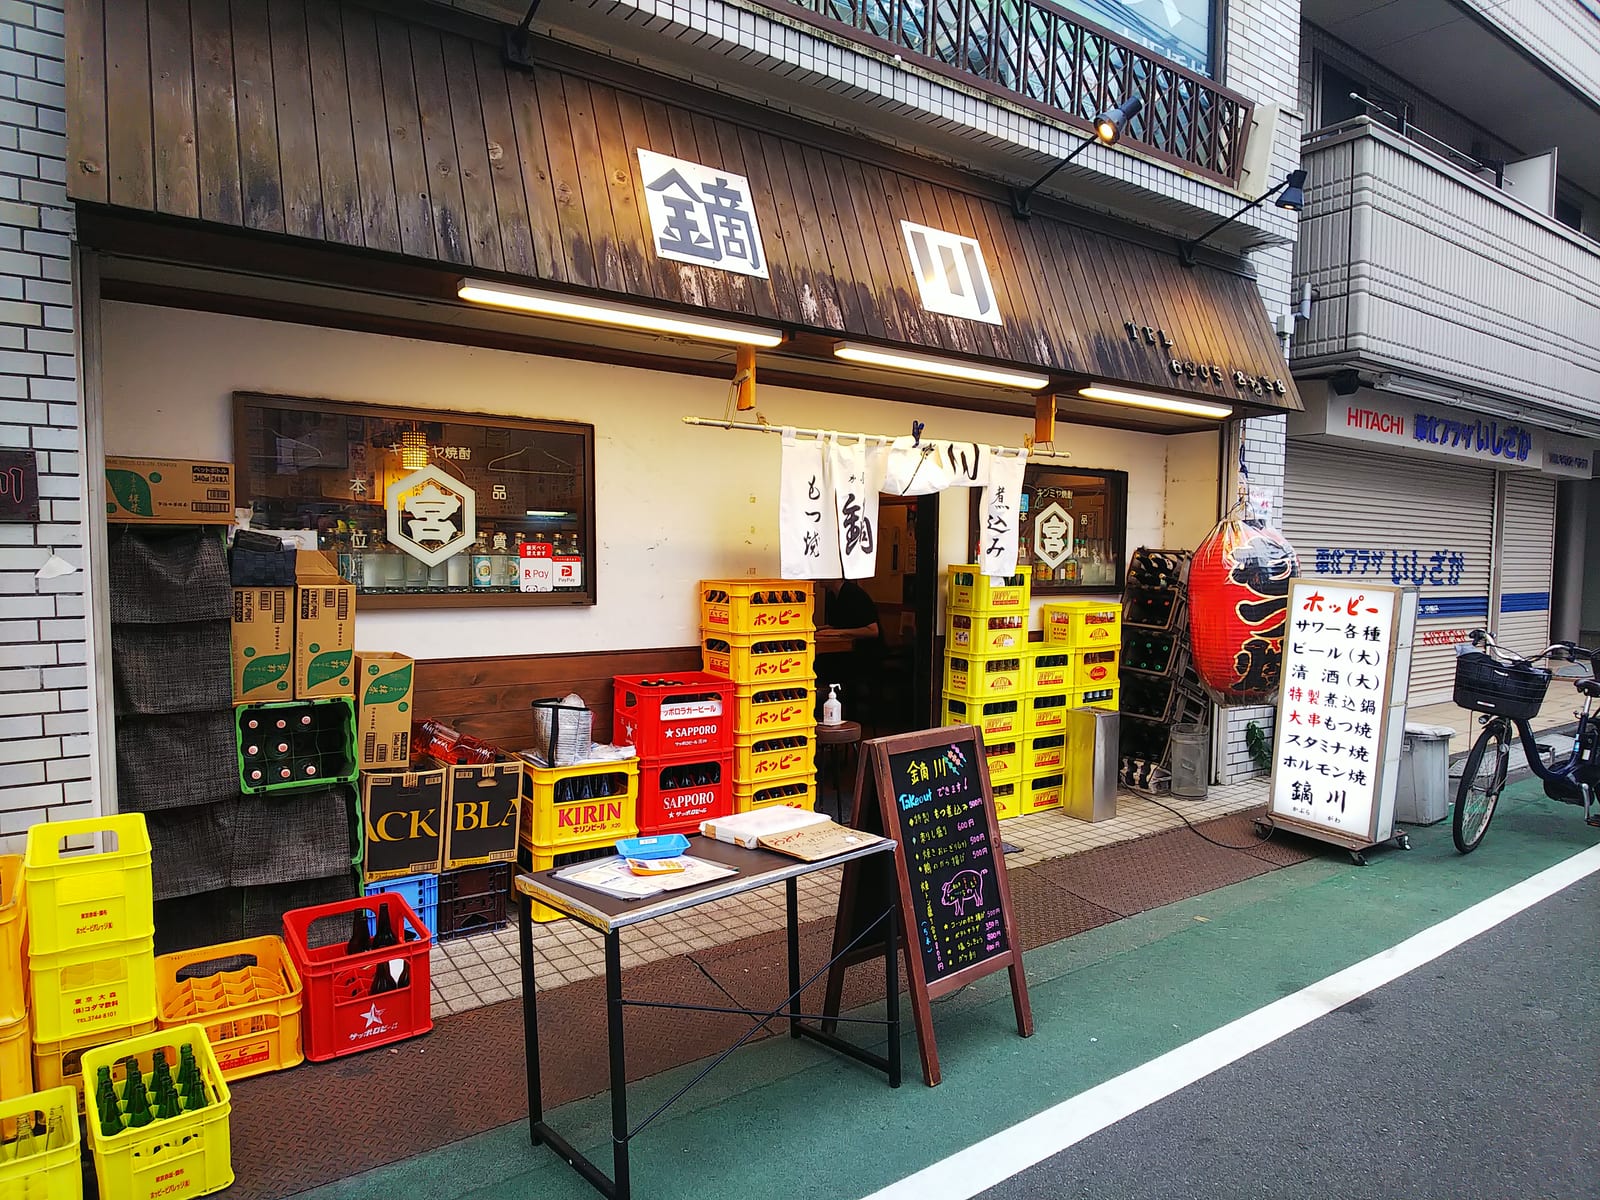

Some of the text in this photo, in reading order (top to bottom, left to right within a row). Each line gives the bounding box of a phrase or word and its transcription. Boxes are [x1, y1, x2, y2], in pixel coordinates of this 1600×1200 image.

[911, 231, 991, 315] 川
[1347, 407, 1404, 435] HITACHI
[1303, 591, 1379, 616] ホッピー
[754, 609, 801, 626] ホッピー
[1295, 619, 1381, 642] サワー各種
[754, 658, 801, 675] ホッピー
[755, 706, 802, 725] ホッピー
[675, 725, 717, 738] SAPPORO
[1285, 733, 1369, 763] スタミナ焼
[755, 754, 802, 773] ホッピー
[1283, 755, 1367, 787] ホルモン焼
[664, 792, 714, 810] SAPPORO
[899, 788, 933, 811] Takeout
[558, 802, 622, 828] KIRIN
[573, 823, 607, 834] キリンビール
